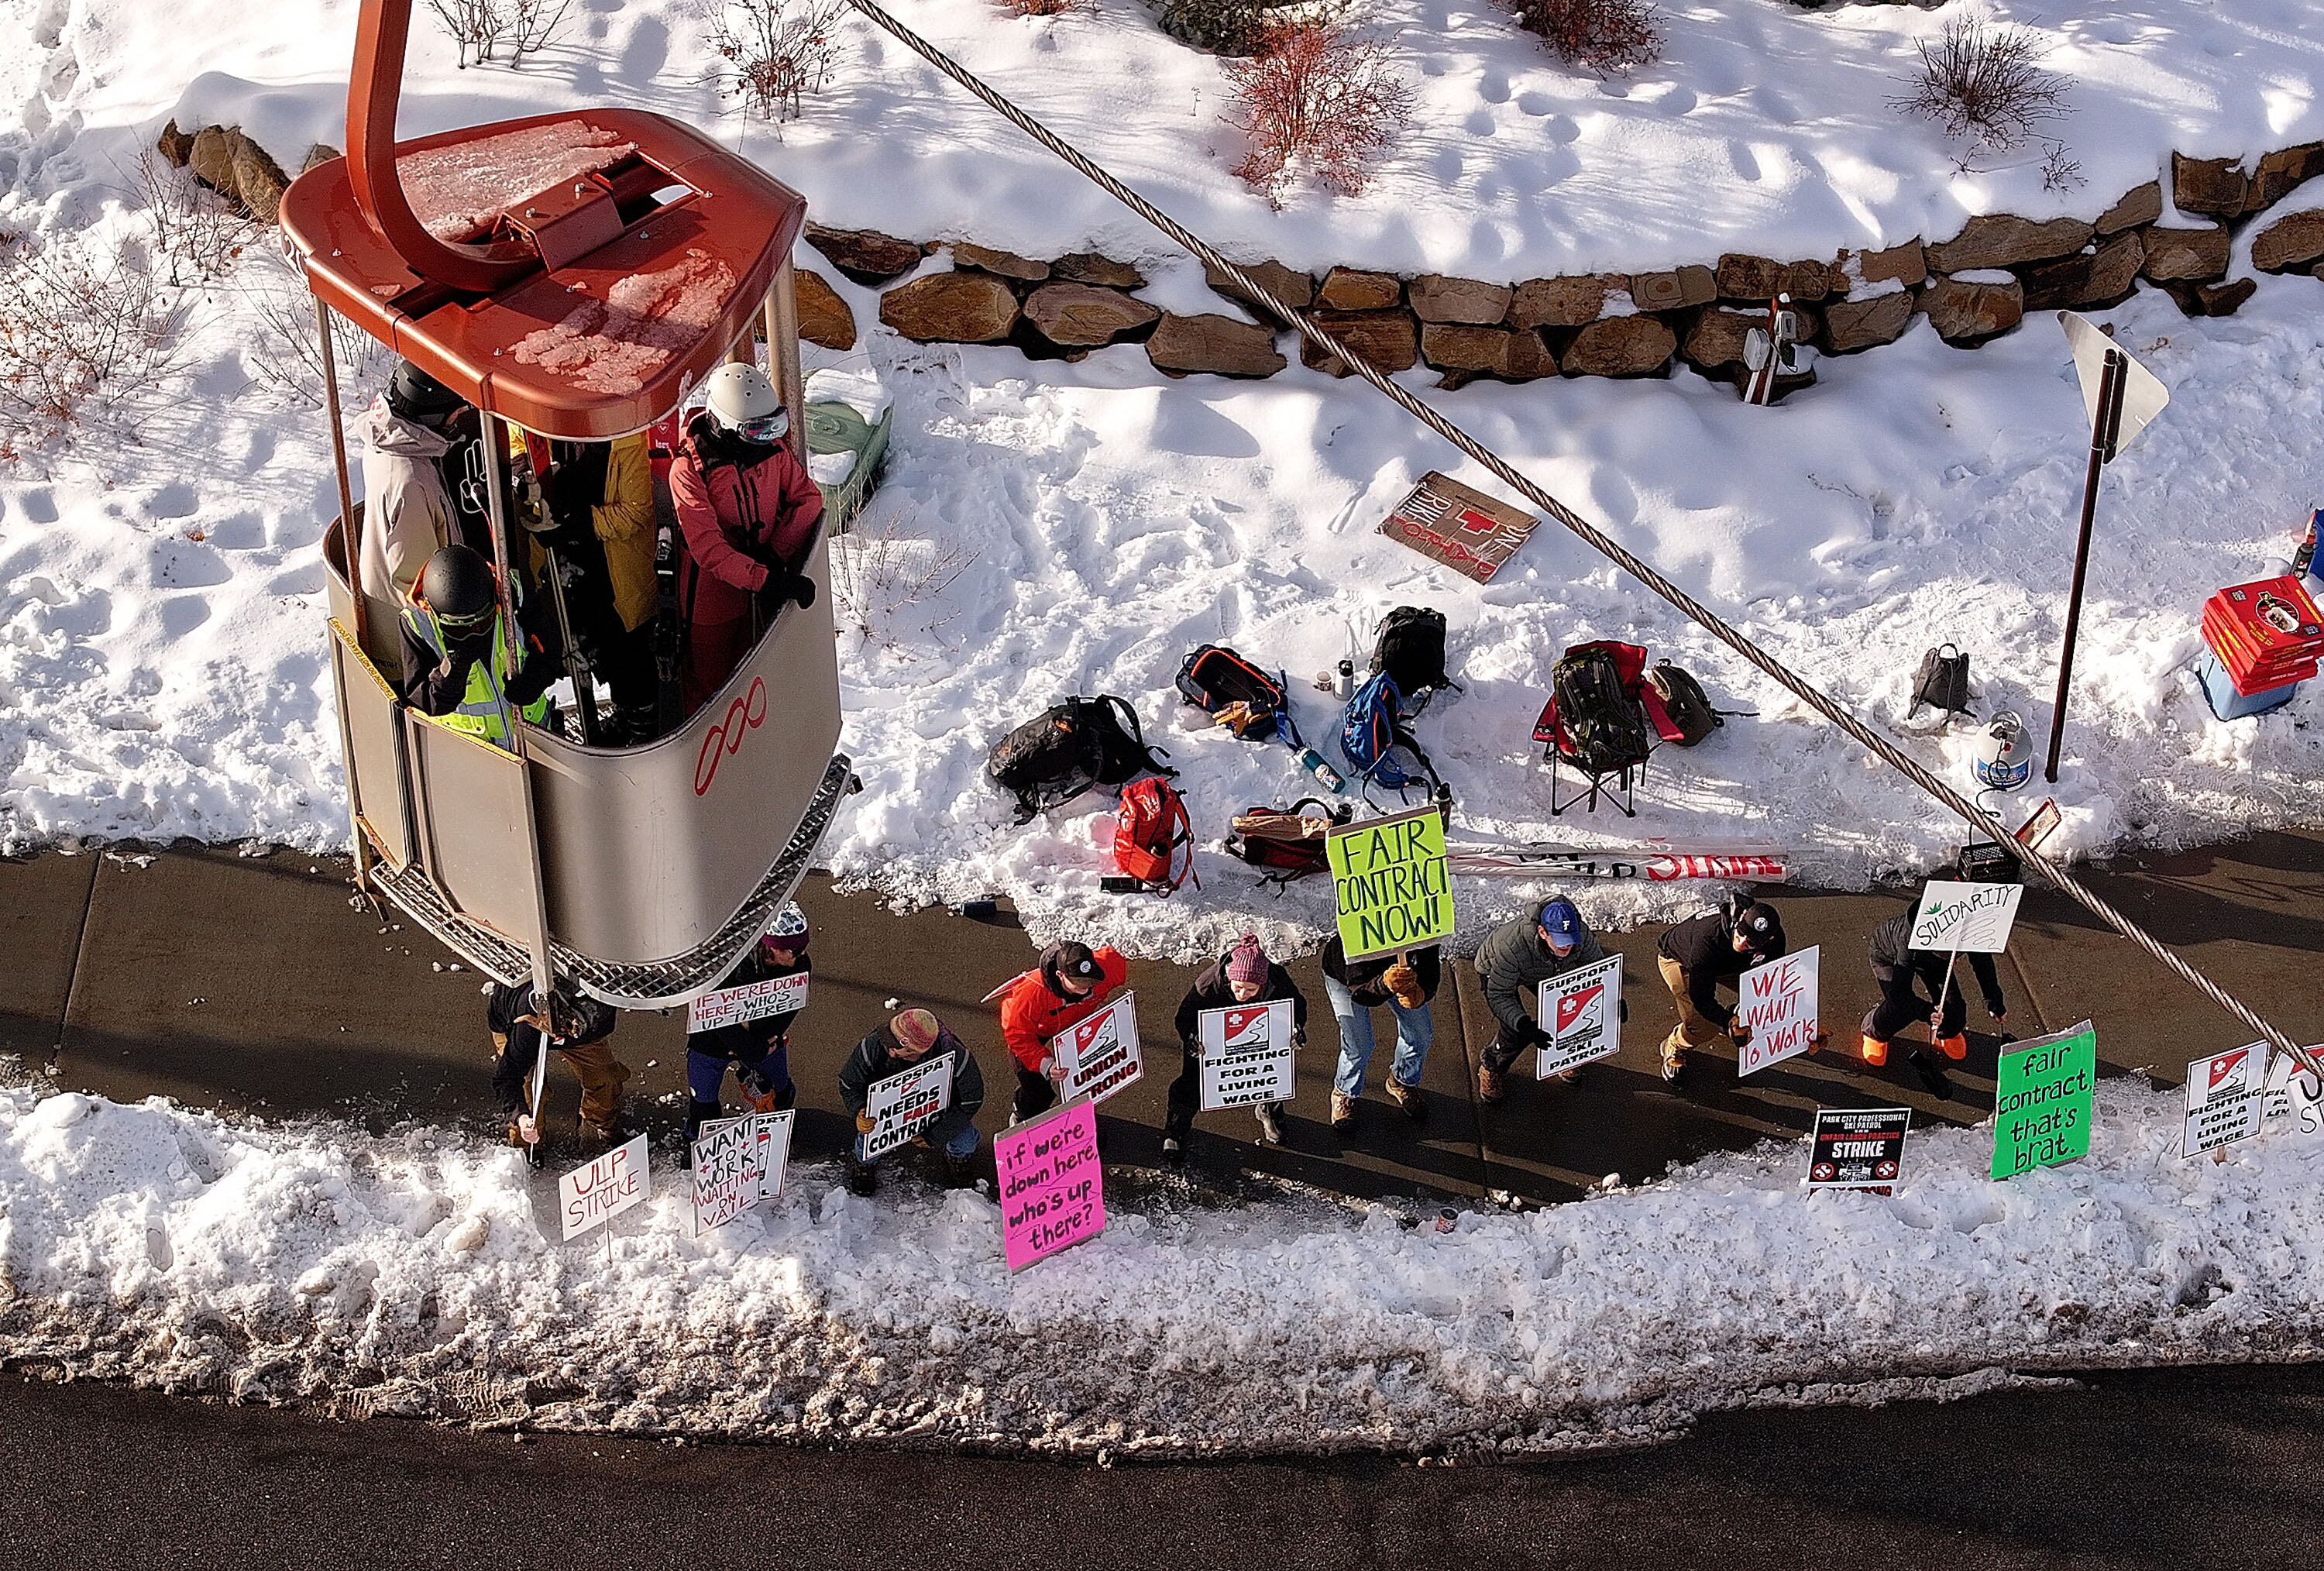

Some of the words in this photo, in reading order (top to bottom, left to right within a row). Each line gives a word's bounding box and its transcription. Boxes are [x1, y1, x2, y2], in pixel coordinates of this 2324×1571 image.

[1342, 820, 1433, 875] FAIR
[1336, 855, 1447, 916] CONTRACT
[1360, 896, 1441, 950] NOW!
[1917, 885, 2017, 946] SOLIDARITY
[696, 993, 715, 1008] IF
[773, 974, 807, 992] DOWN
[1545, 961, 1618, 992] SUPPORT
[1561, 977, 1602, 996] YOUR
[1752, 957, 1801, 997] WE
[702, 1017, 724, 1030] UP
[730, 998, 800, 1023] THERE?
[744, 990, 790, 1009] WHO'S
[1747, 987, 1804, 1030] WANT
[1205, 1048, 1290, 1068] FIGHTING
[1550, 1044, 1608, 1071] PATROL
[1567, 1040, 1593, 1055] SKI
[2023, 1047, 2071, 1078] fair
[880, 1061, 944, 1093] PCPSPA
[1070, 1061, 1138, 1100] RONG
[1073, 1047, 1127, 1088] UNION
[1218, 1076, 1278, 1093] LIVING
[1220, 1067, 1257, 1079] FOR
[1262, 1064, 1274, 1073] A
[878, 1085, 940, 1122] NEEDS
[1222, 1090, 1274, 1105] WAGE
[1997, 1068, 2092, 1116] contract,
[2188, 1088, 2261, 1118] FIGHTING
[868, 1109, 945, 1153] CONTRAC
[882, 1119, 893, 1132] A
[902, 1099, 940, 1123] FAIR
[1841, 1115, 1857, 1123] CITY
[1858, 1113, 1906, 1122] PROFESSIONAL
[2010, 1107, 2078, 1143] that's
[2197, 1116, 2249, 1140] LIVING
[2200, 1109, 2233, 1126] FOR
[2236, 1105, 2247, 1116] A
[696, 1116, 755, 1163] WANT
[1006, 1142, 1026, 1170] if
[1034, 1123, 1085, 1158] we're
[1832, 1140, 1886, 1158] STRIKE
[1868, 1131, 1900, 1140] PRACTICE
[2015, 1132, 2075, 1171] brat.
[2200, 1129, 2245, 1150] WAGE
[573, 1149, 627, 1195] ULP
[697, 1148, 755, 1193] WORK
[712, 1150, 737, 1170] TO
[1005, 1168, 1050, 1198] down
[1054, 1144, 1099, 1177] here,
[569, 1170, 639, 1227] STRIKE
[697, 1165, 758, 1207] WAITING
[719, 1191, 736, 1208] ON
[1009, 1191, 1063, 1228] who's
[1067, 1179, 1092, 1201] up
[1029, 1203, 1093, 1250] there?
